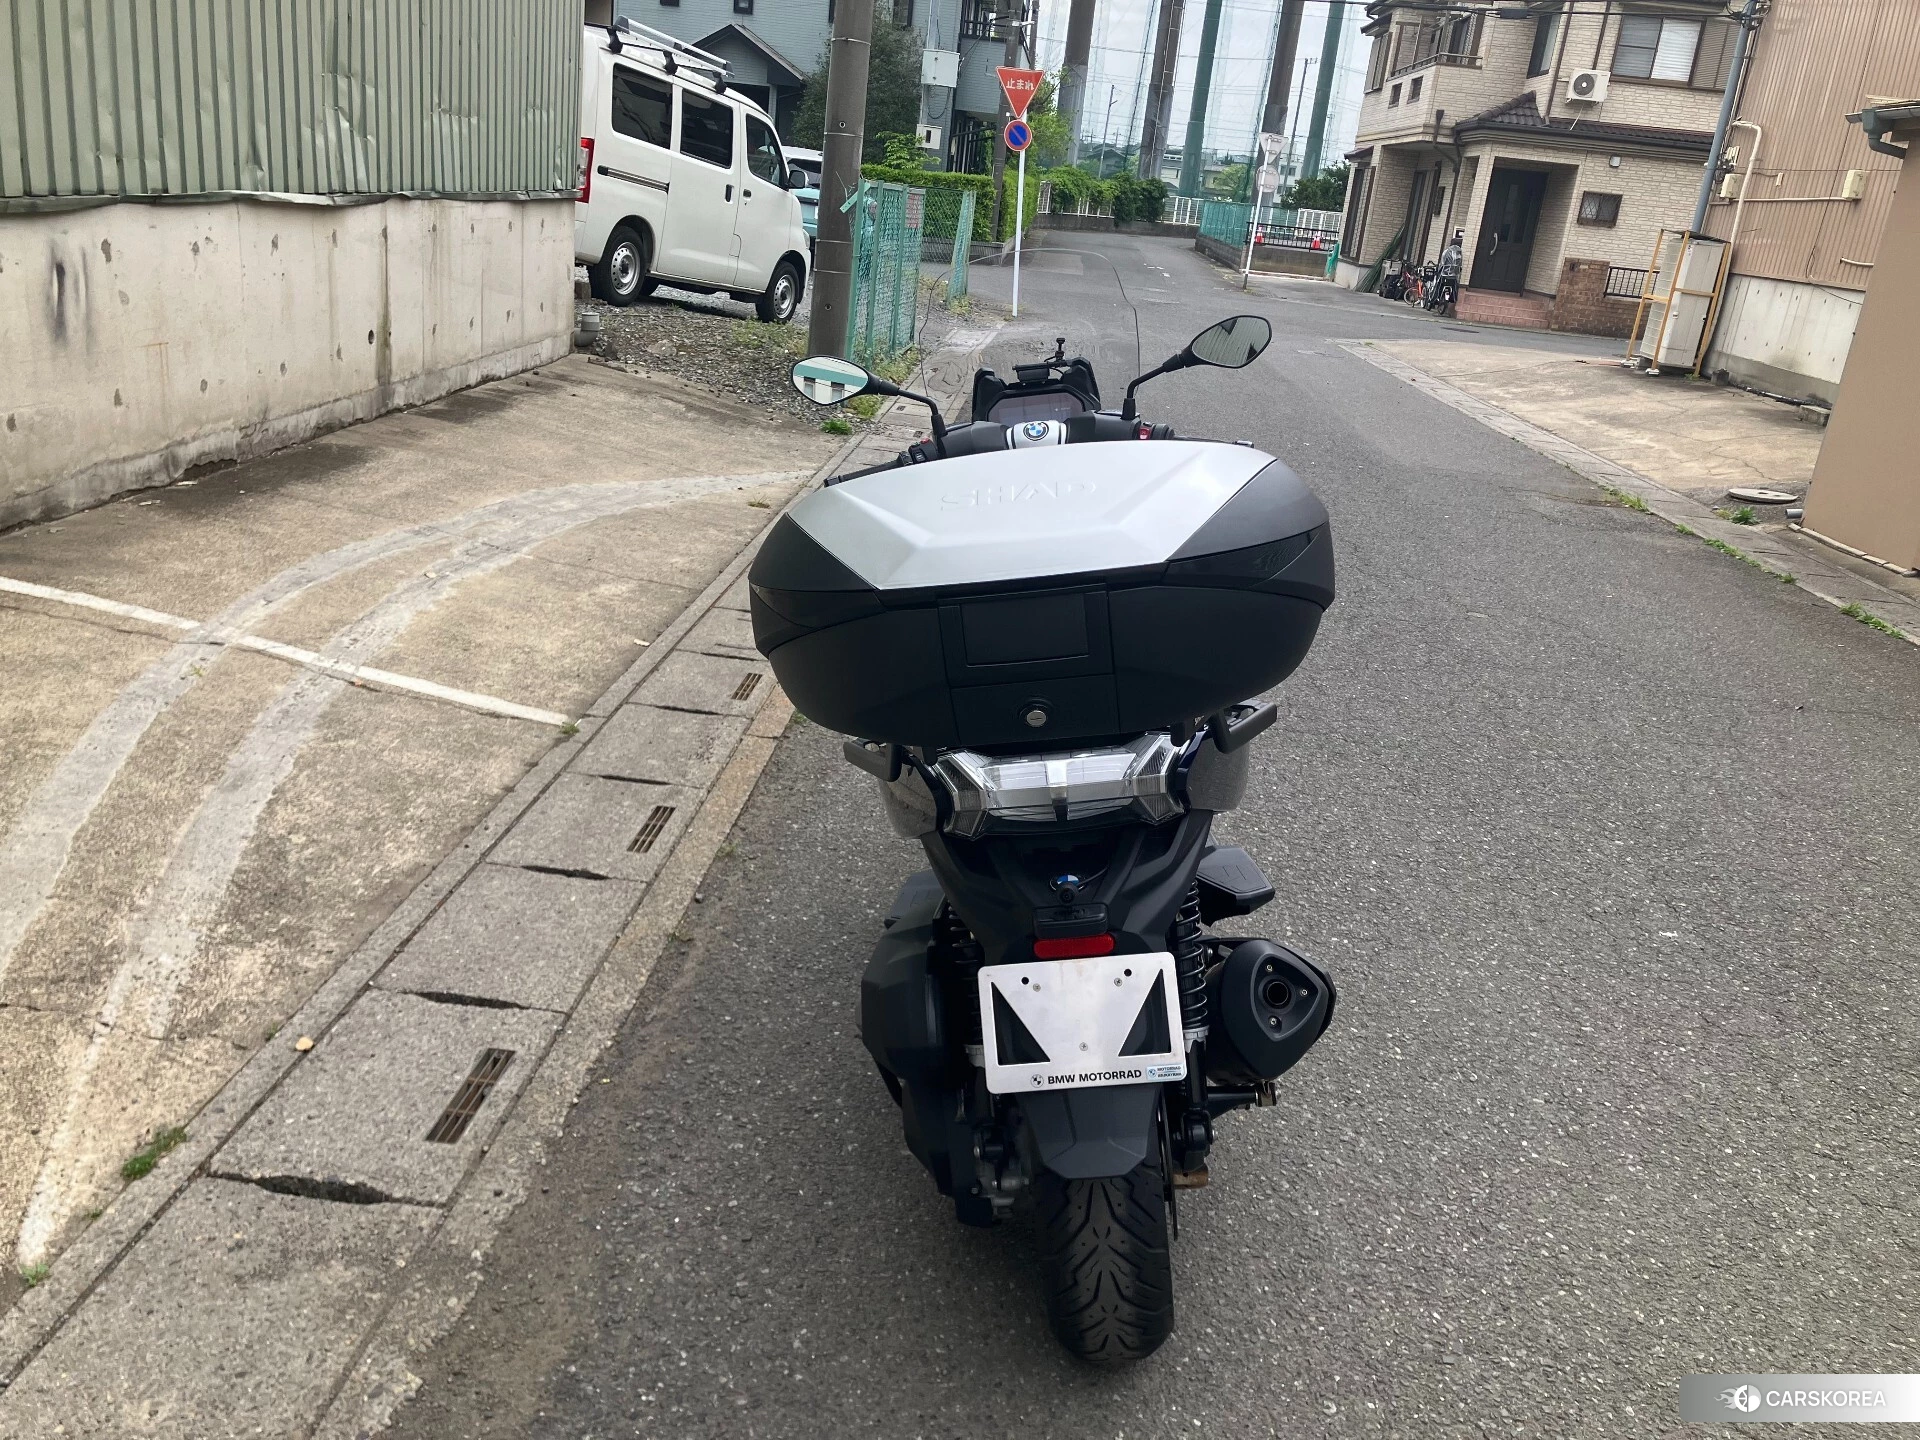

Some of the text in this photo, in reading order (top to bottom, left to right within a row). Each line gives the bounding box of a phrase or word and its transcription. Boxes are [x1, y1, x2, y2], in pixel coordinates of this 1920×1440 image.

[1006, 77, 1034, 91] 止まれ
[1047, 1069, 1142, 1084] BMW MOTORRAD
